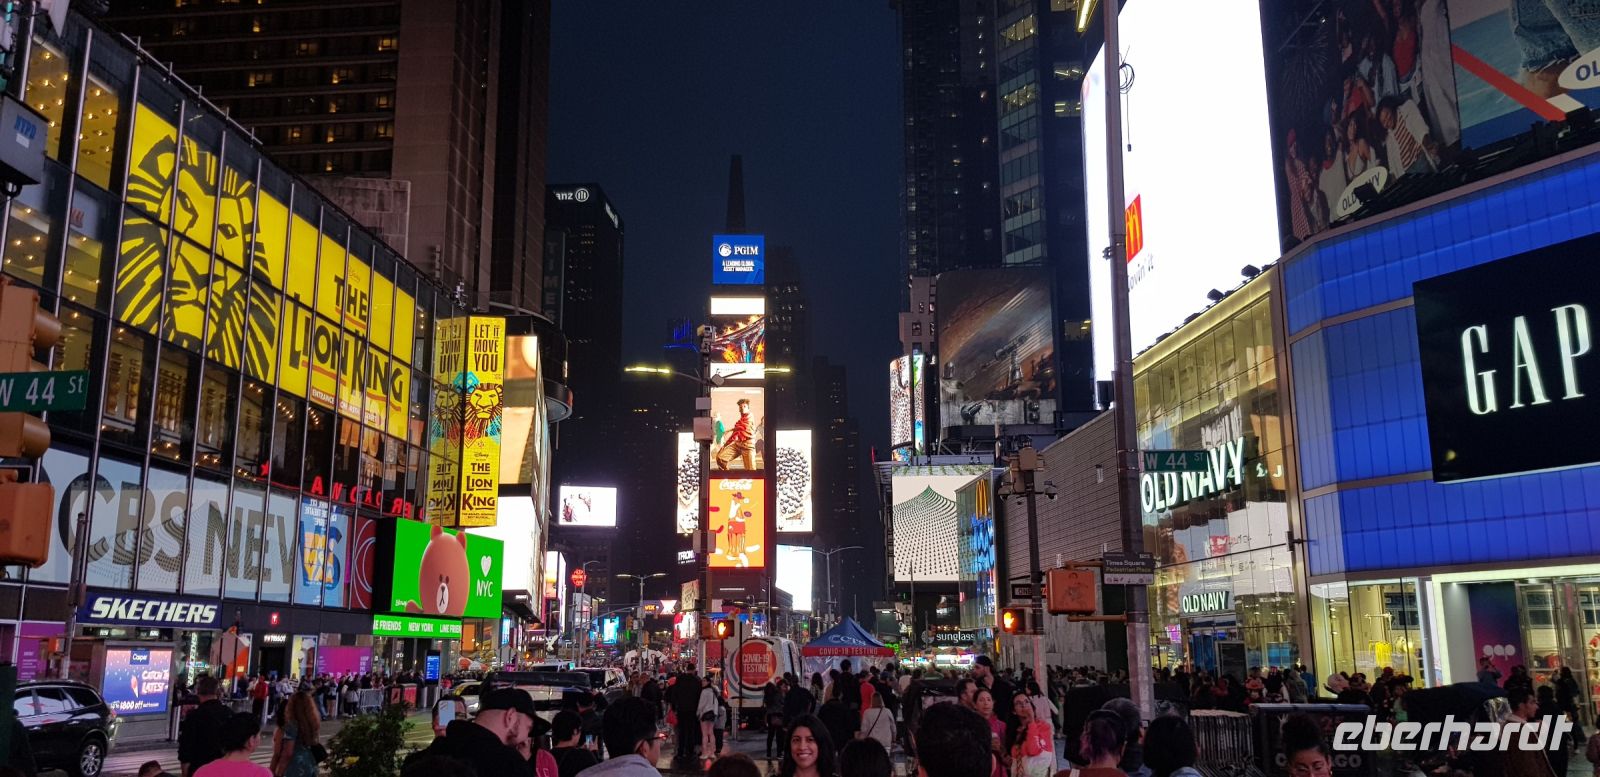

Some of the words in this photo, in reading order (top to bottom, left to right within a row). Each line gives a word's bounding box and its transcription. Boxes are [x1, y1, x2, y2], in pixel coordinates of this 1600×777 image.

[14, 114, 37, 140] NYPD
[734, 246, 759, 256] PGIM
[334, 274, 368, 322] THE
[475, 324, 490, 338] LET
[289, 292, 350, 377] LION
[351, 328, 403, 403] KING
[474, 339, 499, 353] MOVE
[474, 353, 498, 372] YOU
[1462, 303, 1592, 415] GAP
[25, 377, 55, 405] 44
[67, 375, 84, 394] St
[470, 462, 491, 472] THE
[1146, 454, 1158, 470] W
[1165, 454, 1187, 469] 44
[1194, 452, 1204, 462] ST
[1141, 472, 1178, 513] OLD
[1182, 436, 1245, 502] NAVY
[466, 476, 493, 492] LION
[461, 493, 496, 511] KING
[58, 472, 190, 573] CBS
[477, 579, 494, 597] NYC
[90, 596, 218, 624] SKECHERS
[1182, 595, 1200, 613] OLD
[1200, 590, 1227, 612] NAVY
[380, 620, 402, 631] FRIENDS
[408, 622, 420, 632] NEW
[420, 623, 433, 633] YORK
[440, 623, 449, 633] LINE
[936, 632, 976, 643] sunglass
[132, 653, 147, 662] Casper
[742, 653, 770, 663] COVID-19
[820, 647, 849, 655] COVID-19
[851, 647, 878, 655] TESTING
[1483, 644, 1516, 661] gap
[742, 663, 769, 673] TESTING
[135, 700, 143, 709] off
